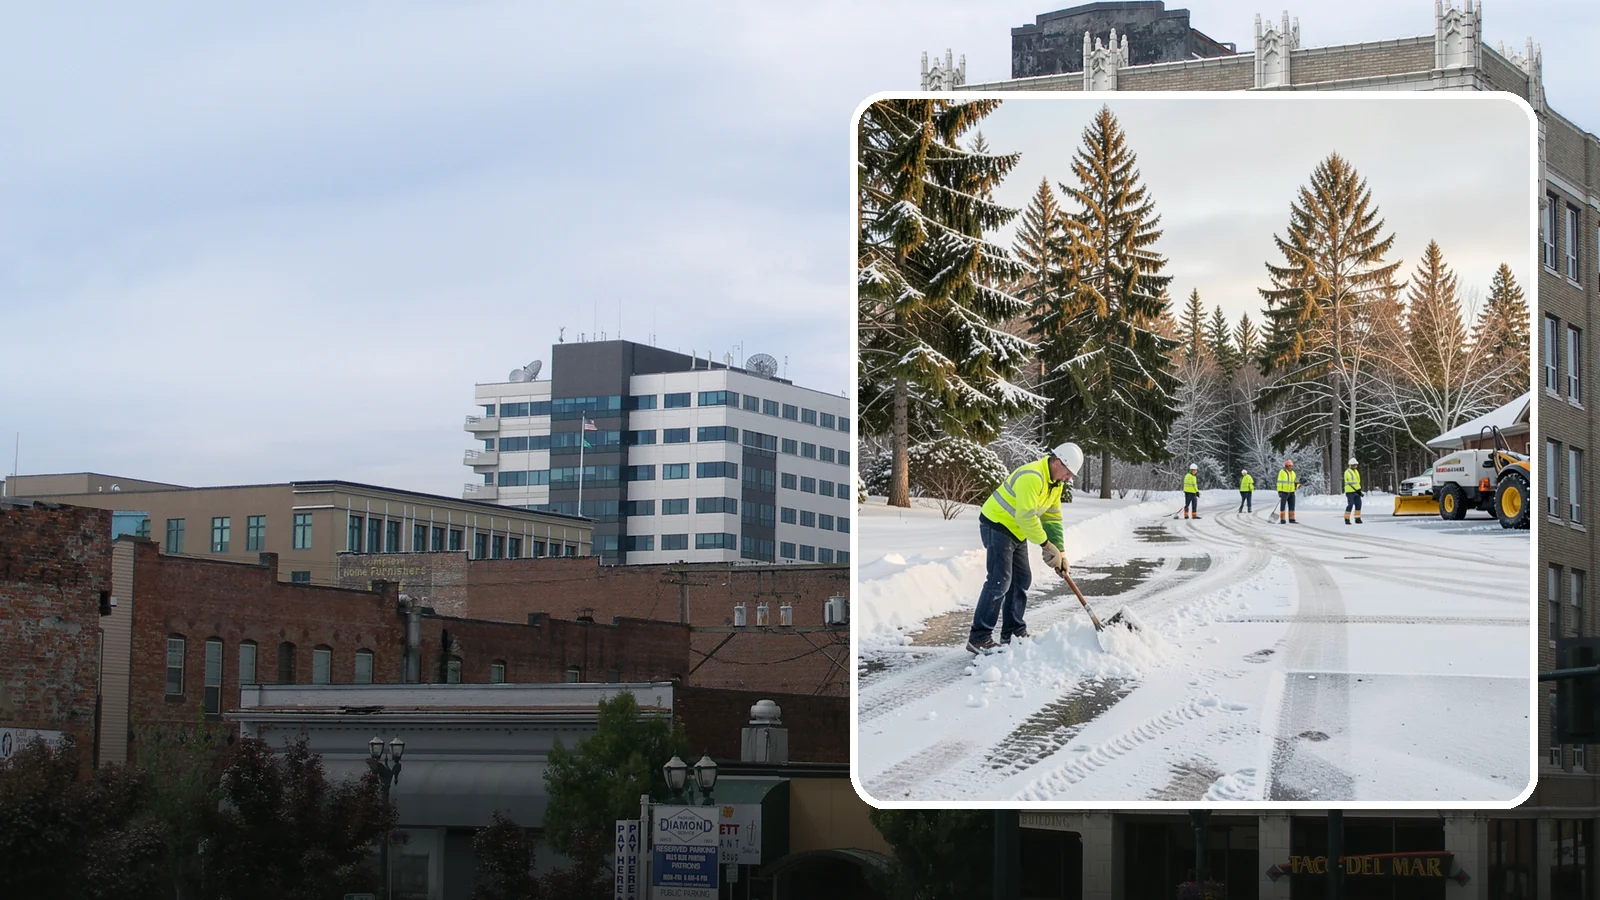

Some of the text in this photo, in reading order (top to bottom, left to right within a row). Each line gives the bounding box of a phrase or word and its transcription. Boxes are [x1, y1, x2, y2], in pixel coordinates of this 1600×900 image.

[343, 566, 427, 577] Home Furnishers
[660, 818, 713, 833] DIAMOND
[1022, 815, 1069, 828] BUILDING
[656, 845, 716, 854] RESERVED PARKING
[617, 825, 625, 893] PAY HERE
[628, 825, 636, 893] PAY HERE
[671, 862, 701, 870] PATRONS
[1346, 855, 1385, 875] DEL
[1392, 857, 1442, 877] MAR
[660, 888, 710, 898] PUBLIC PARKING
